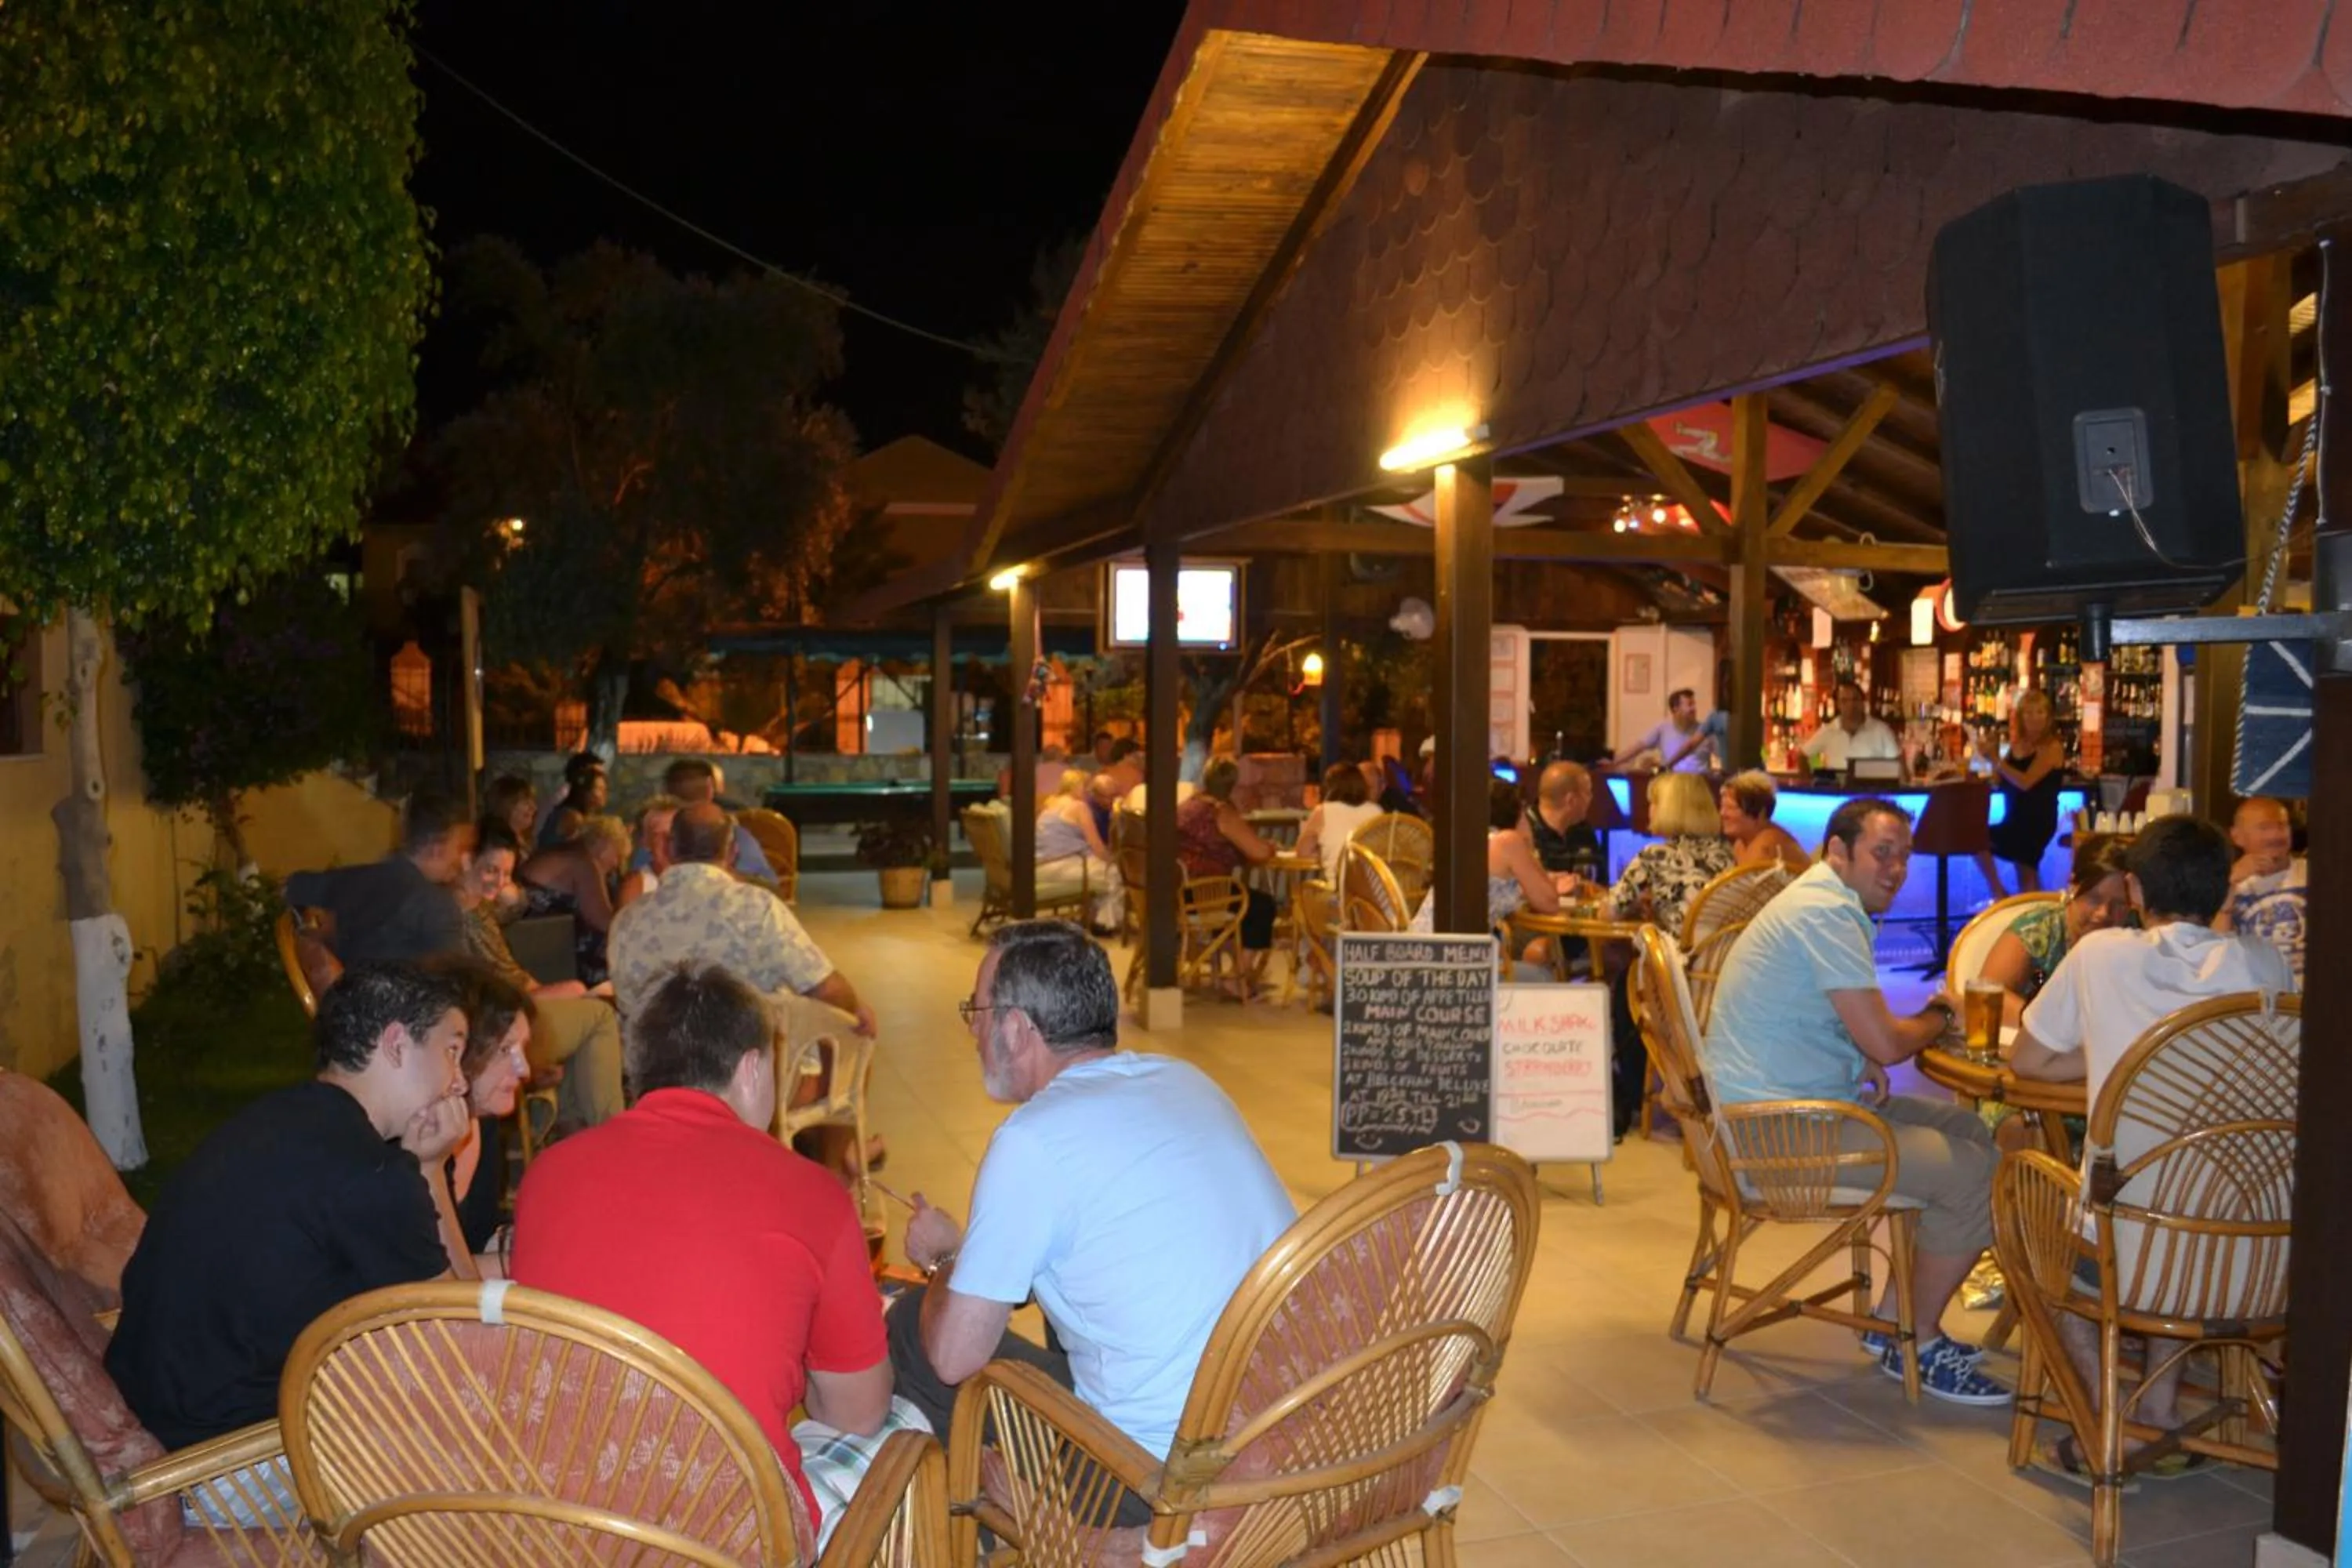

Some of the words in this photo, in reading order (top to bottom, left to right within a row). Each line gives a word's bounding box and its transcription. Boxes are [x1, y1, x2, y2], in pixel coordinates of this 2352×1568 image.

[1344, 943, 1380, 963] HALF
[1385, 942, 1433, 962] BOARD
[1443, 944, 1492, 963] MENU
[1343, 967, 1386, 987] SOUP
[1392, 969, 1414, 988] OF
[1419, 969, 1455, 988] THE
[1457, 970, 1490, 989] DAY
[1400, 988, 1421, 1006] OF
[1363, 1004, 1411, 1020] MAIN
[1414, 1004, 1487, 1025] COURSE
[1392, 1022, 1412, 1038] OF
[1497, 1015, 1545, 1033] MILK
[1348, 1088, 1370, 1103] AT
